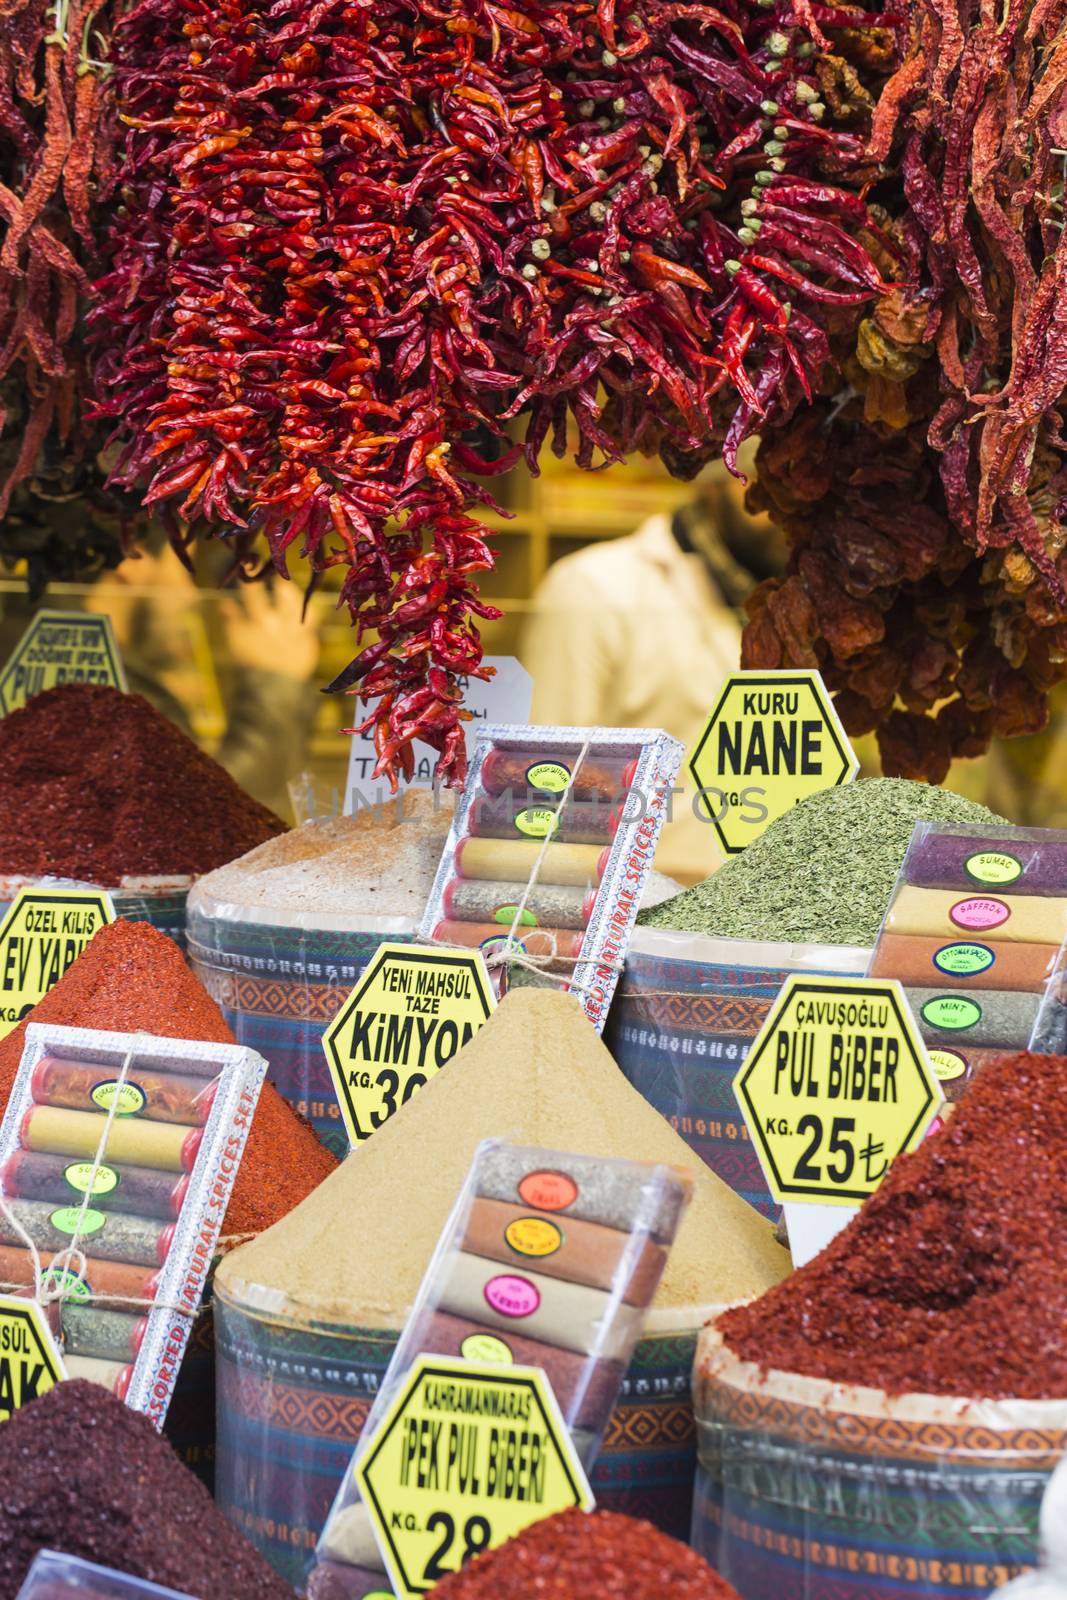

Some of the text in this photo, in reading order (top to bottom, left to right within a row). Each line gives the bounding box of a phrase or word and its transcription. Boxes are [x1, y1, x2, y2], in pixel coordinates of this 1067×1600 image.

[743, 692, 799, 716] KURU
[717, 720, 823, 776] NANE
[720, 792, 743, 807] KG.
[625, 815, 657, 883] SPICES
[979, 856, 1013, 869] SUMAC
[25, 905, 57, 933] ÖZEL
[960, 902, 1002, 915] SAFFRON
[3, 936, 33, 992] EV
[415, 969, 471, 1000] MAHSÜL
[406, 996, 440, 1014] TAZE
[796, 999, 889, 1033] ÇAVUŞOĞLU
[940, 1002, 967, 1013] MINT
[774, 1030, 819, 1098] PUL
[928, 1055, 958, 1069] HILLI
[348, 1071, 374, 1089] KG.
[766, 1117, 793, 1136] KG.
[208, 1136, 241, 1211] SPICES
[233, 1091, 253, 1130] SET
[446, 1423, 480, 1495] PUL
[391, 1511, 422, 1532] KG.
